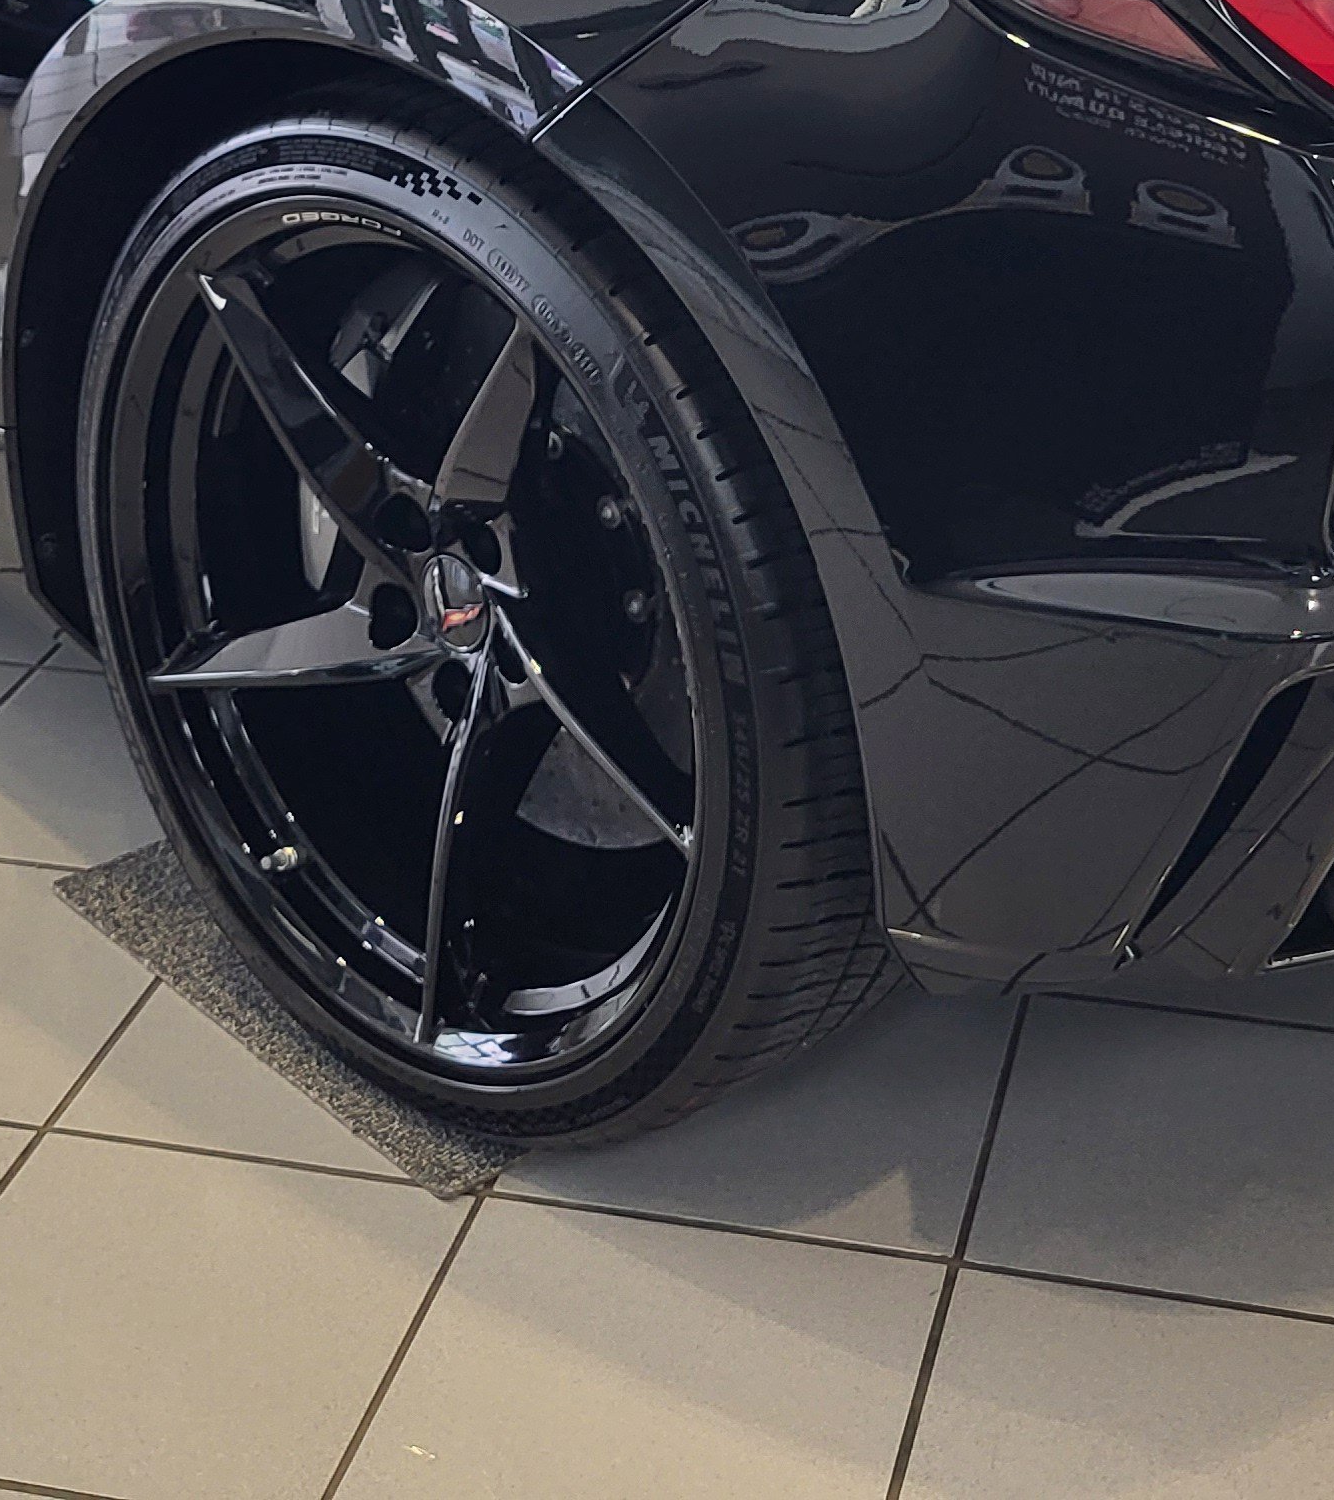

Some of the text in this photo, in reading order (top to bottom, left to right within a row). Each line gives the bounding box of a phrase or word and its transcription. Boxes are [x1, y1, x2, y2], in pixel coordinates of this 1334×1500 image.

[281, 211, 403, 237] FORGED
[462, 228, 486, 252] DOT
[646, 435, 748, 687] MICHELIN
